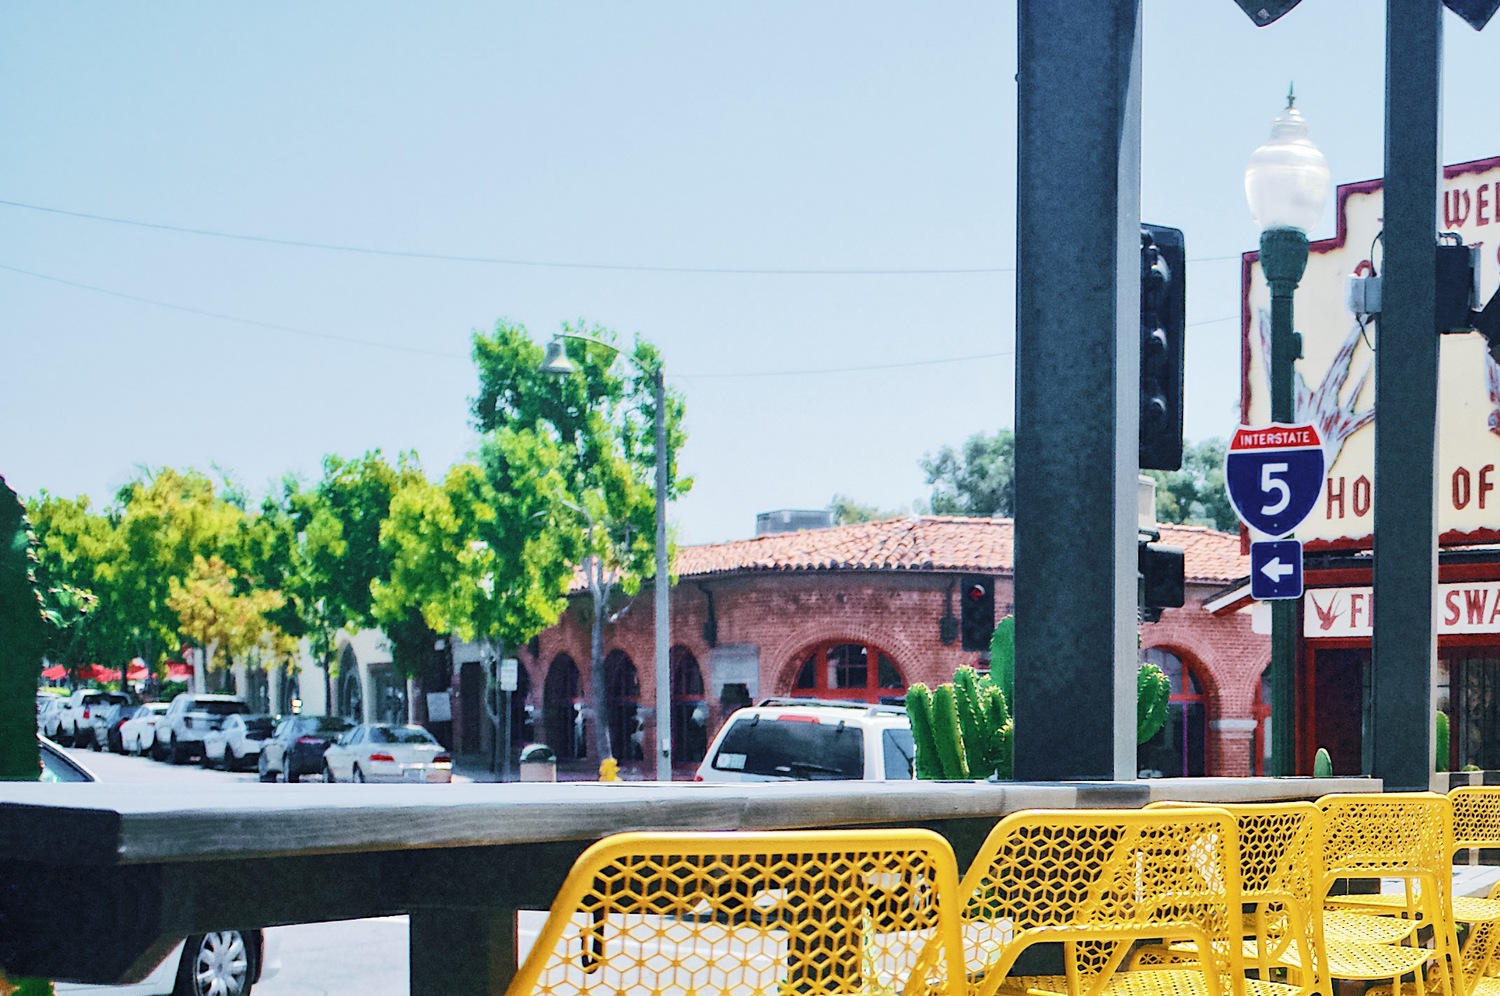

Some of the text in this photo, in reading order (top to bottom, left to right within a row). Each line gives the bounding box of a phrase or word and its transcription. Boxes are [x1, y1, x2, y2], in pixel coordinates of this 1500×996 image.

[1240, 431, 1311, 446] INTERSTATE
[1260, 462, 1291, 516] 5
[1326, 474, 1371, 519] HO
[1452, 464, 1495, 510] OF
